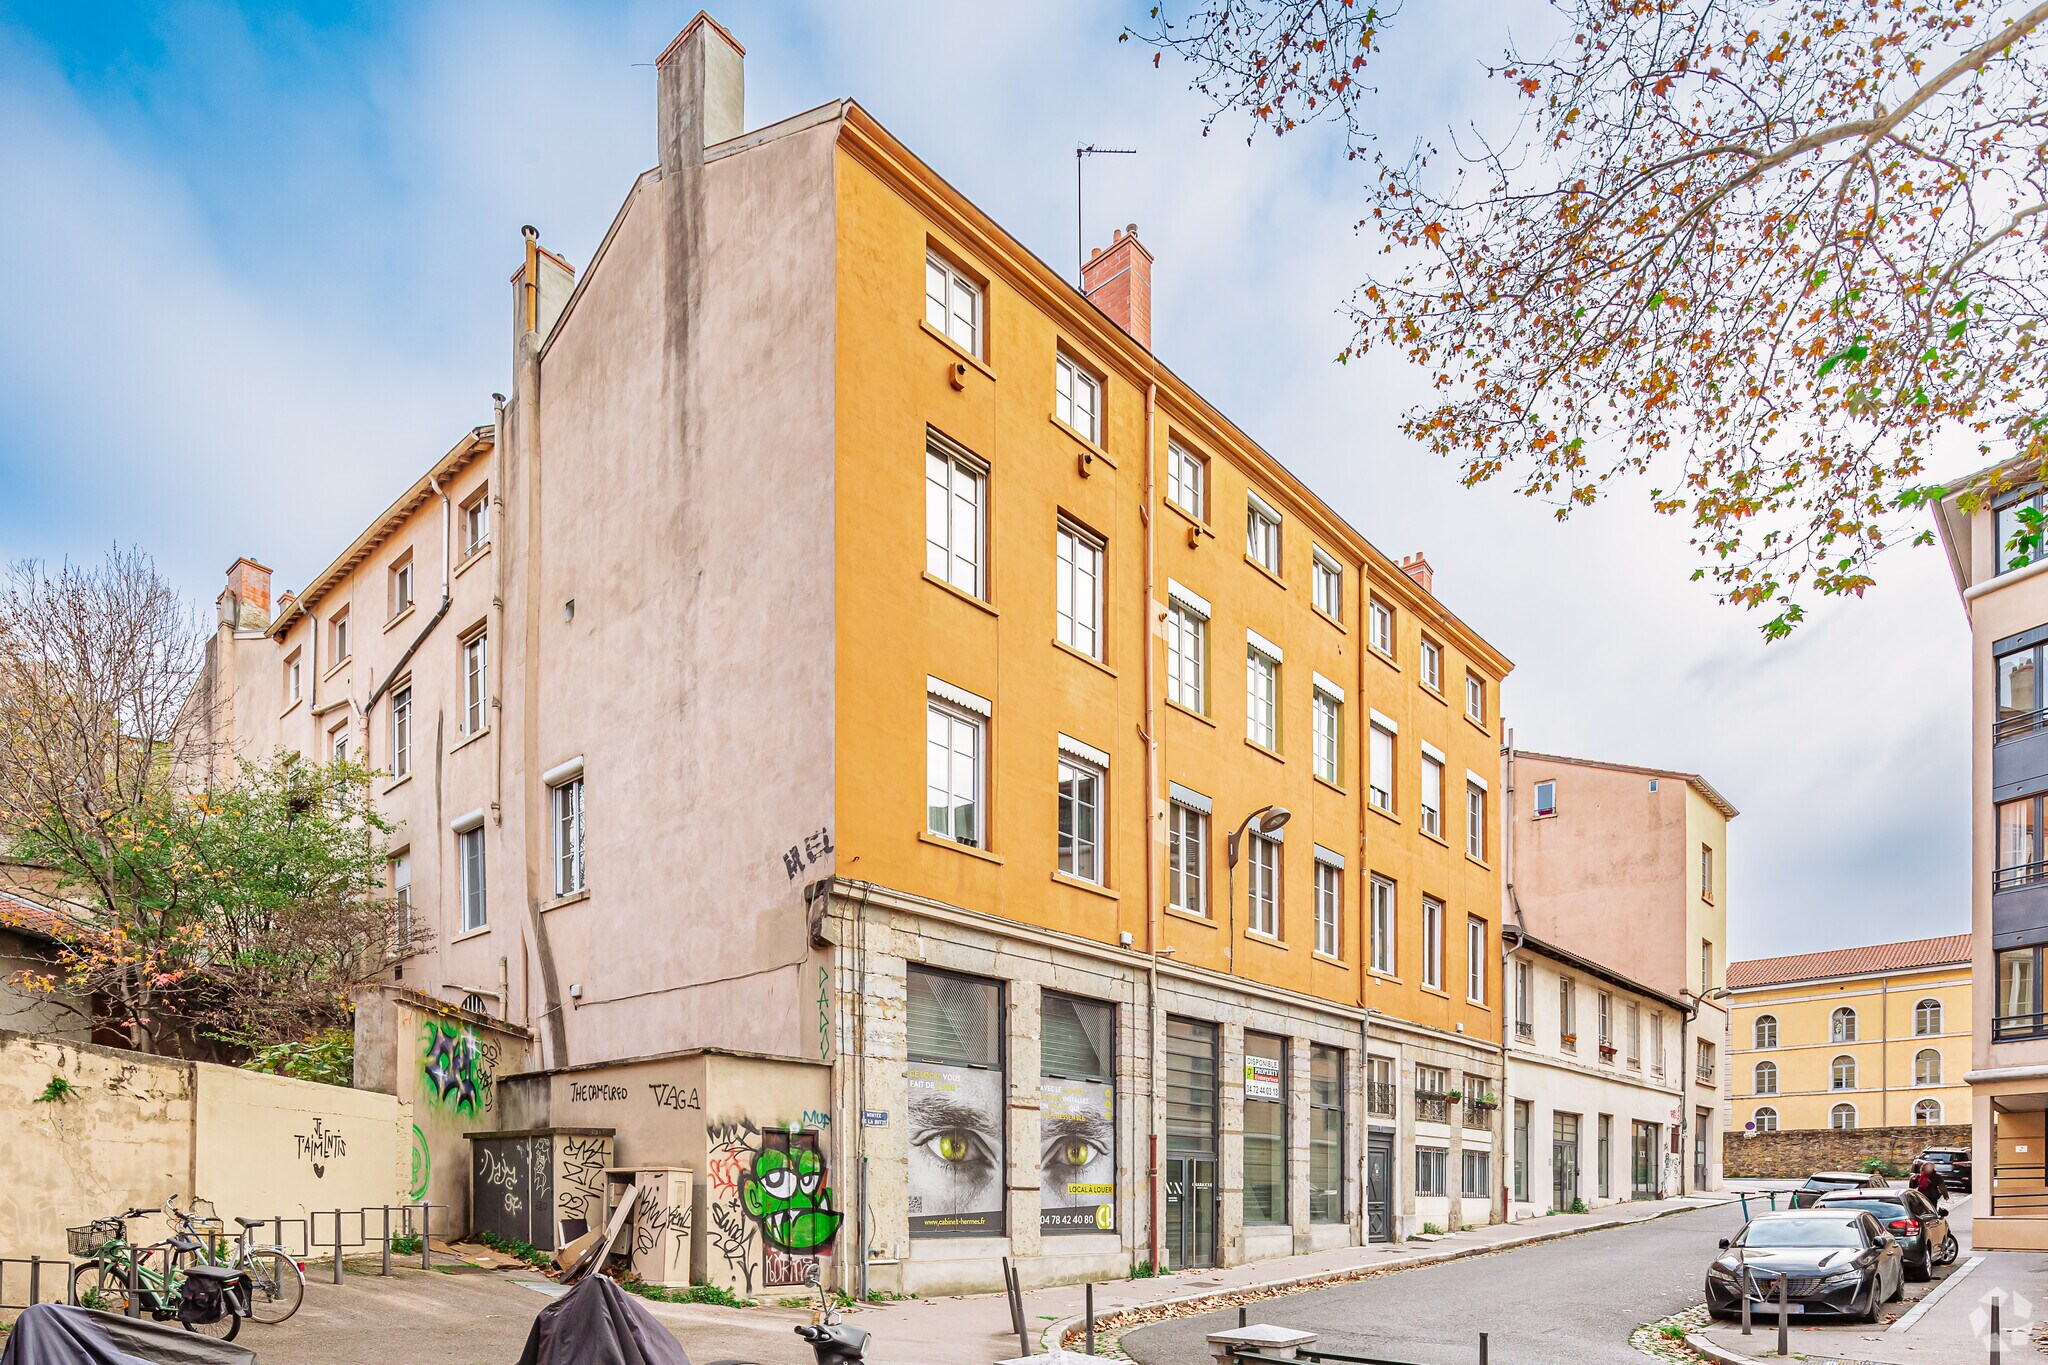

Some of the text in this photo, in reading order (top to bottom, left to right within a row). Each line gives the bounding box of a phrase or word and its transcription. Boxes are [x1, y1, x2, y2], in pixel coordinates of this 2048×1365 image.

[1247, 1057, 1277, 1069] DISPONIBLE
[909, 1070, 961, 1082] CE LOCAL VOUS
[1255, 1067, 1278, 1077] PROPERTY
[909, 1080, 924, 1088] FAIT
[925, 1081, 935, 1089] DE
[649, 1084, 701, 1110] VAGA
[1062, 1096, 1089, 1104] INSTALLEZ
[312, 1117, 323, 1139] JE
[1088, 1184, 1093, 1193] À
[1093, 1186, 1113, 1194] LOUER
[924, 1217, 986, 1226] www.cabinet-hermes.fr
[1040, 1214, 1094, 1225] 04 78 42 40 80
